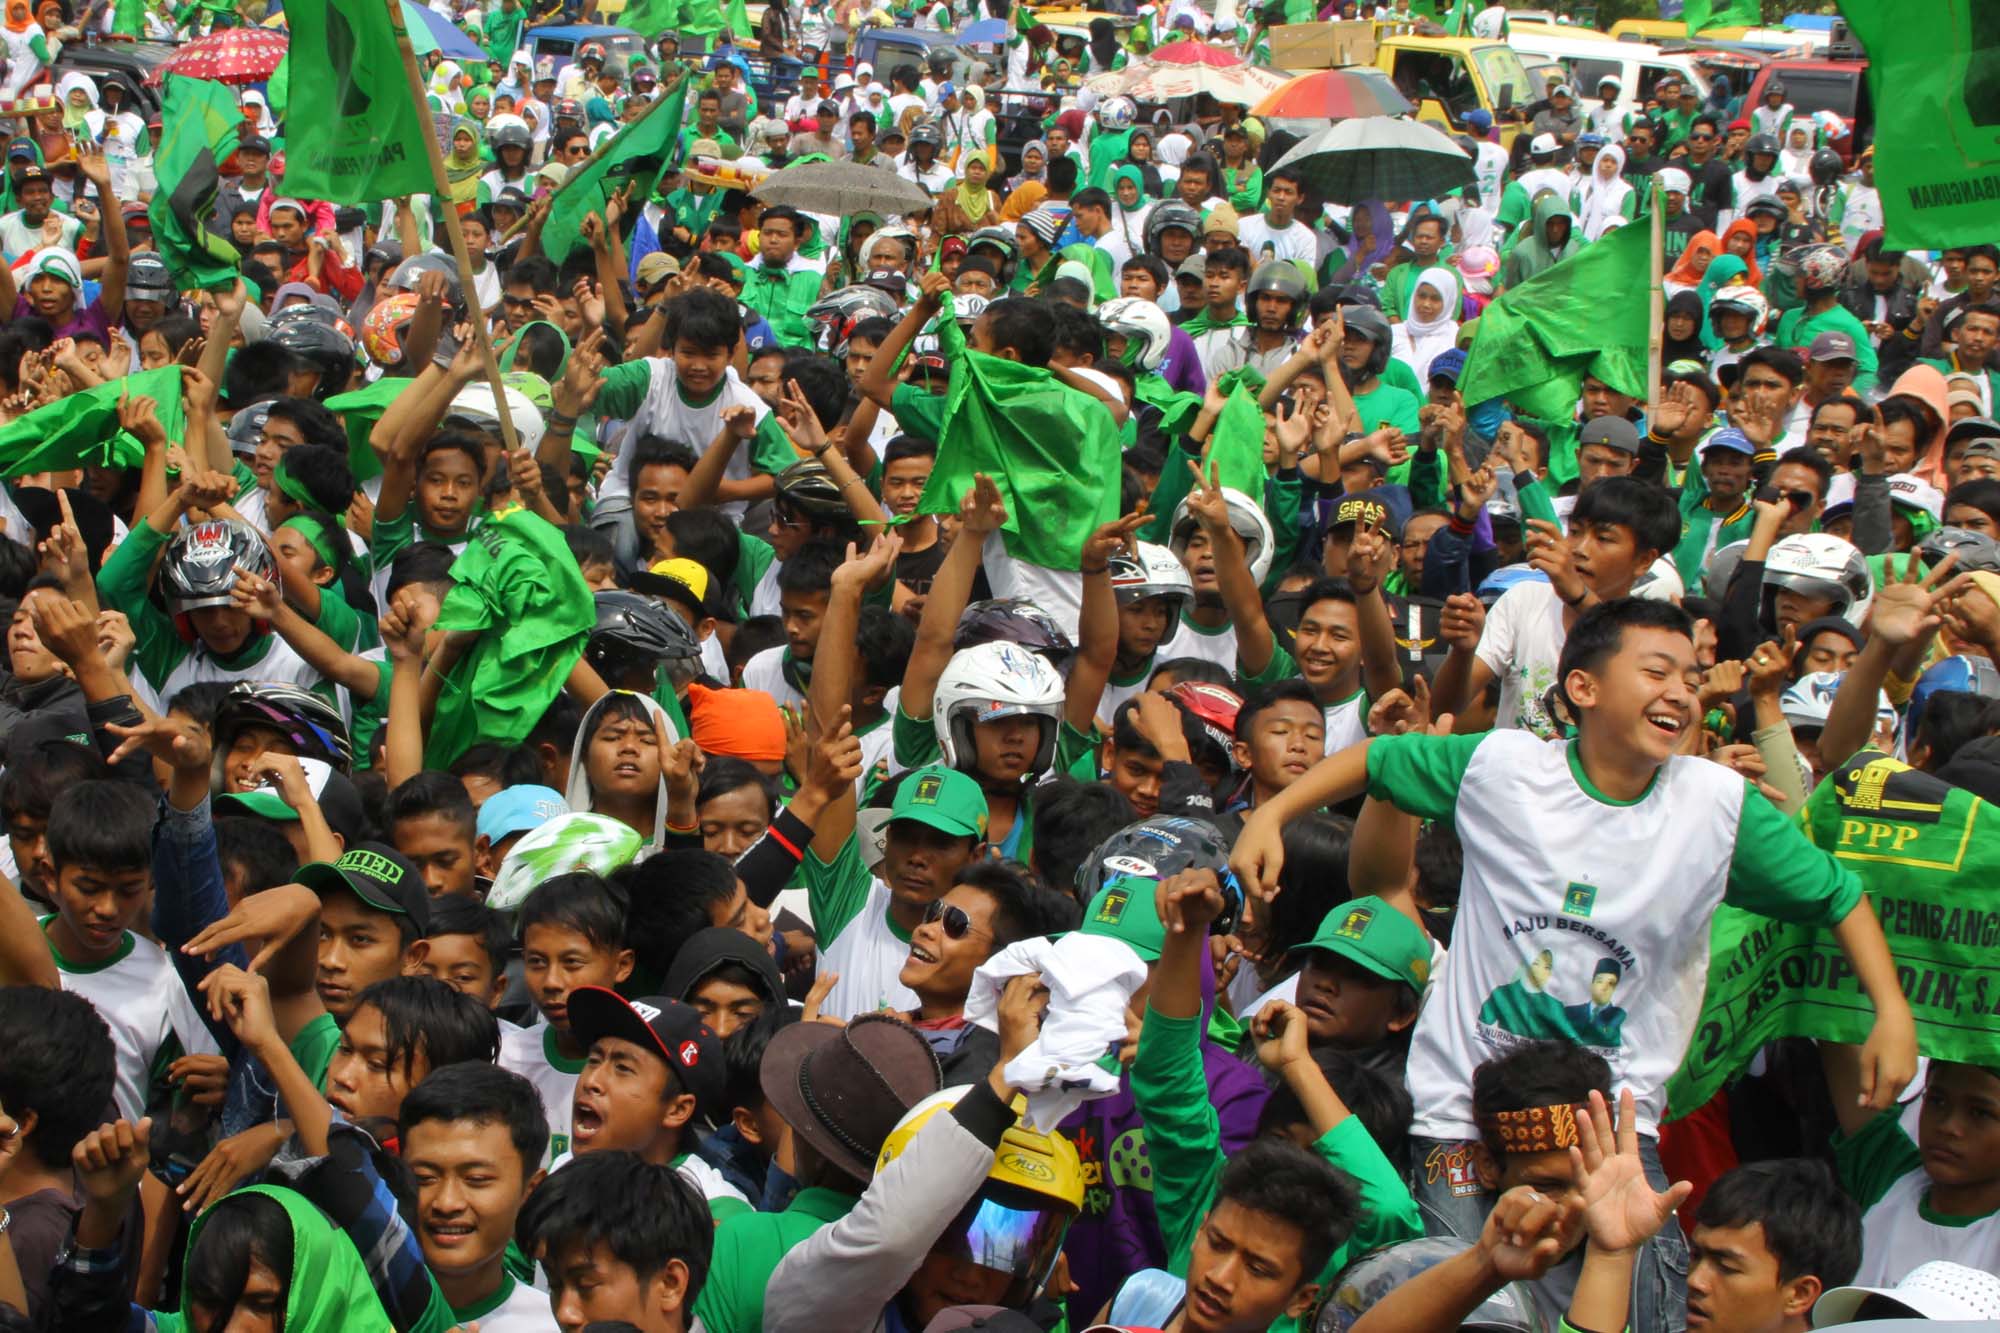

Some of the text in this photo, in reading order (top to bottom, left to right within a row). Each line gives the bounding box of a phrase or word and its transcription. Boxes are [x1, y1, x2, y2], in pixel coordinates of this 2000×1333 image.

[1838, 820, 1919, 851] PPP
[1116, 858, 1146, 872] GM
[1556, 917, 1637, 971] BERSAMA
[1698, 1021, 1728, 1064] 2
